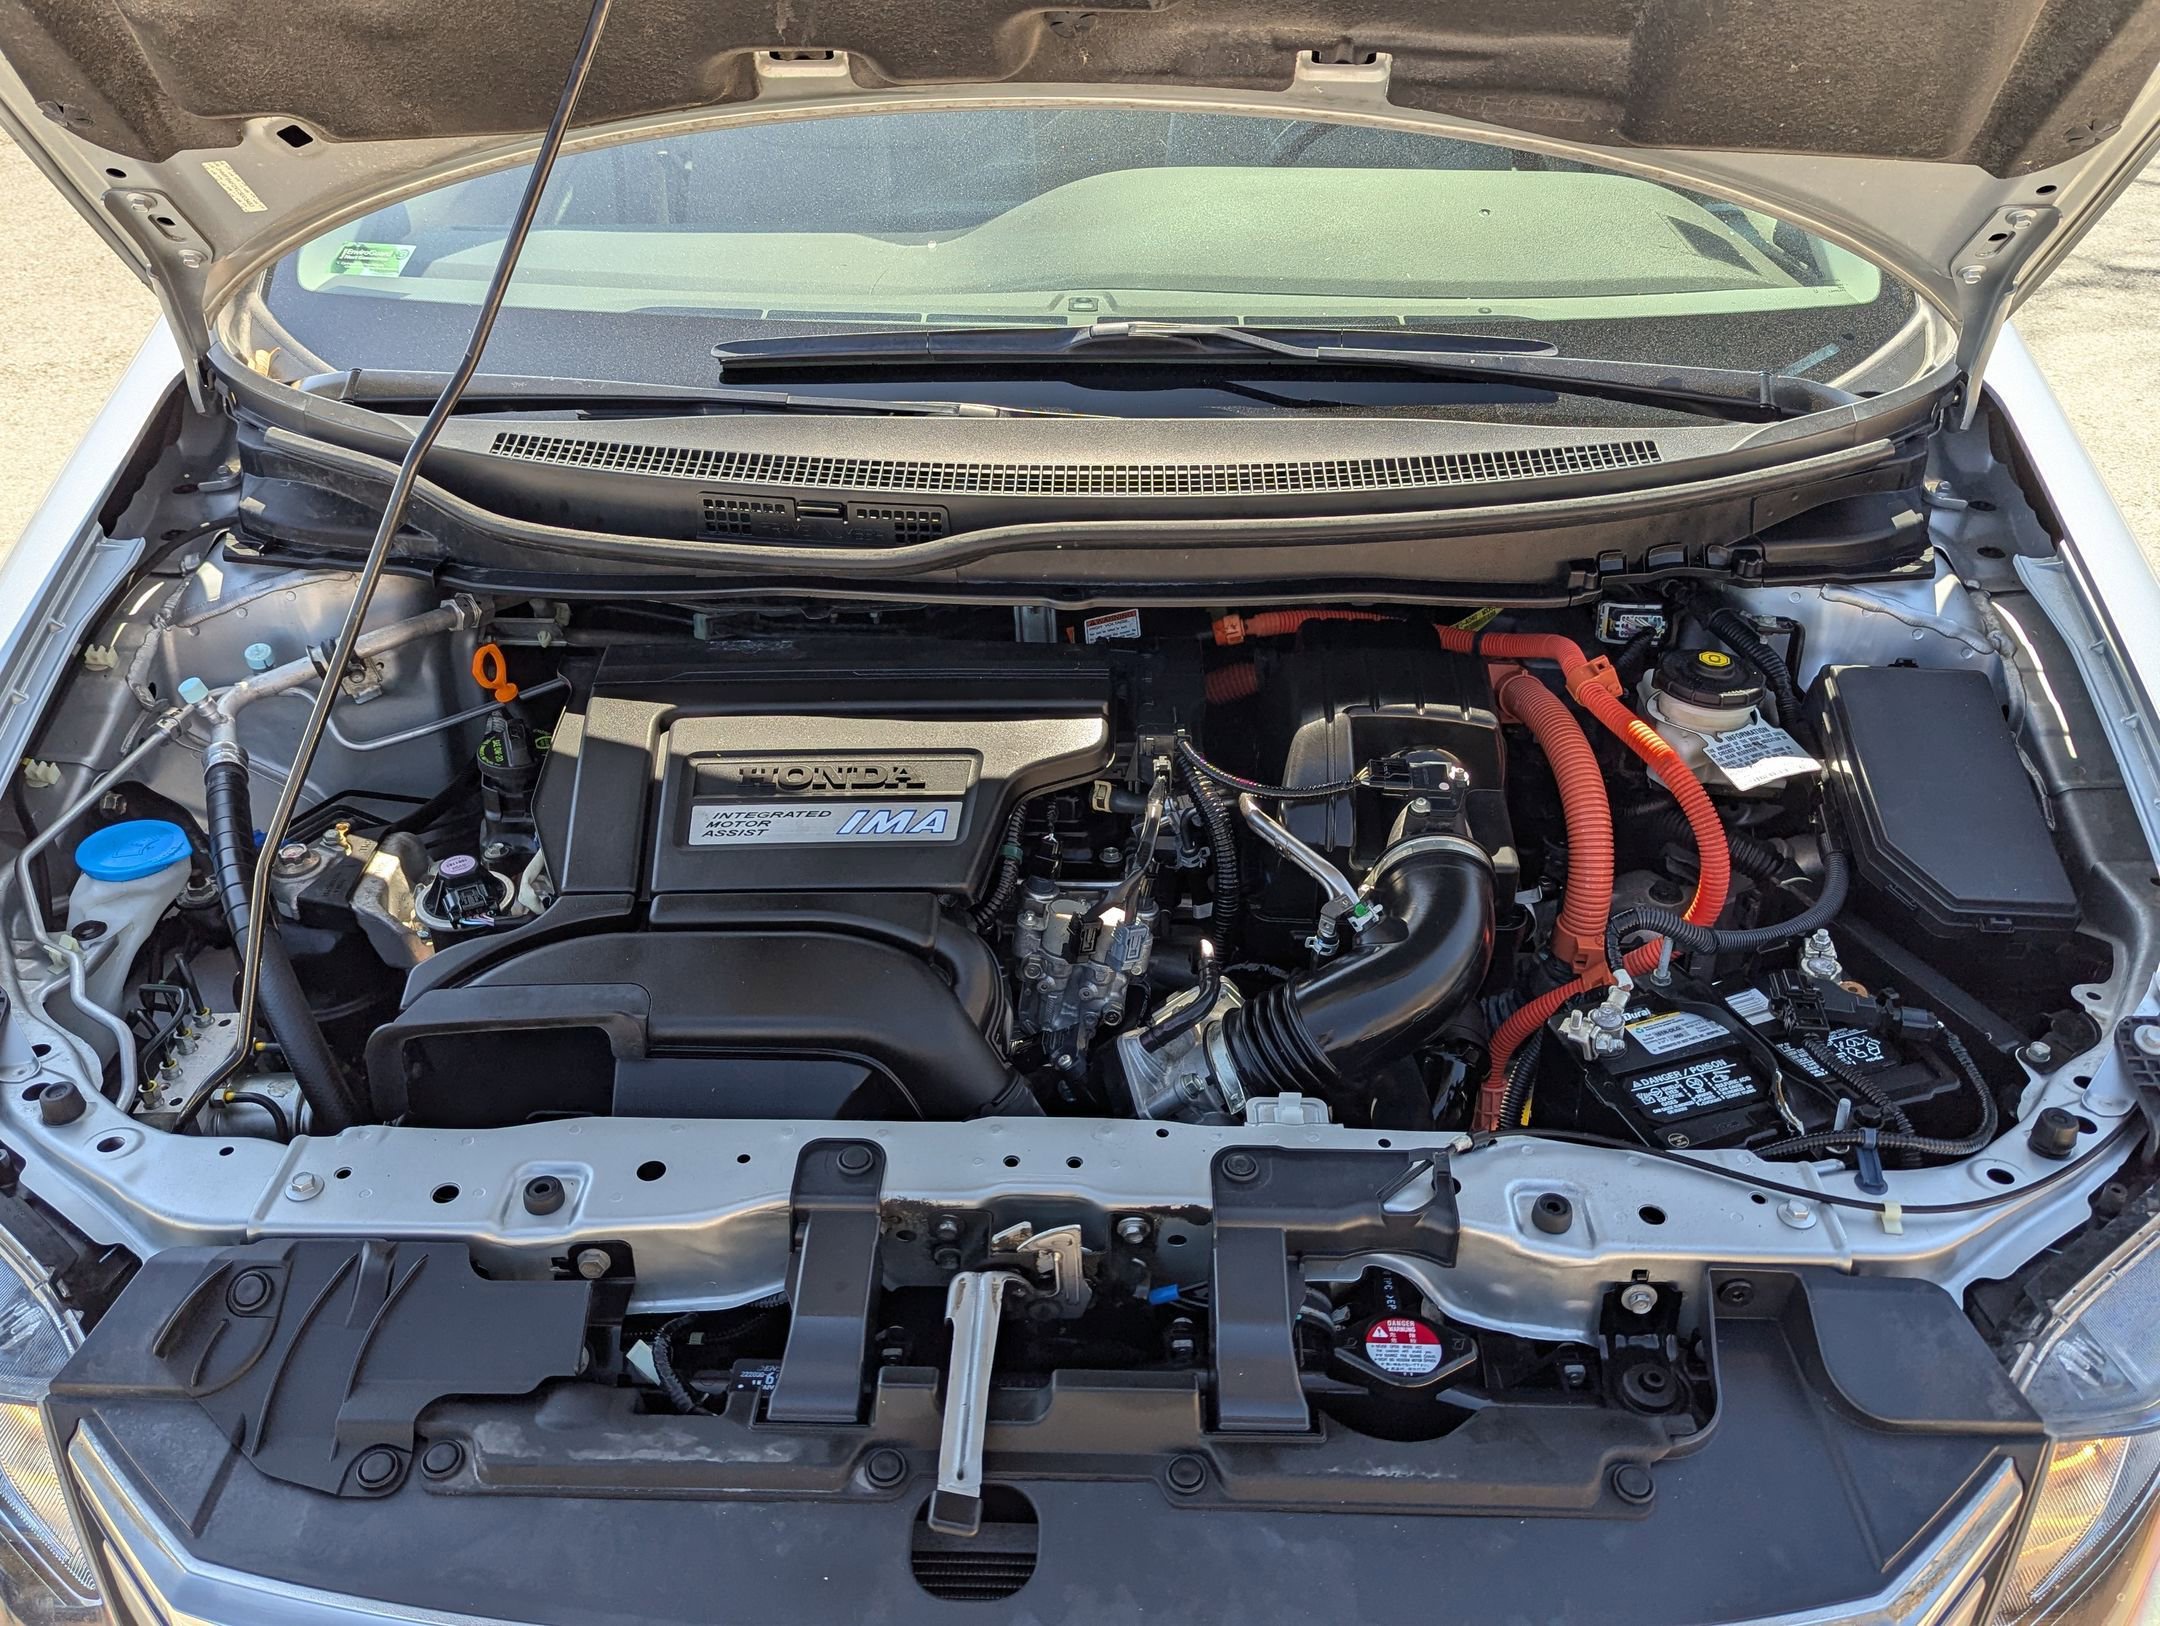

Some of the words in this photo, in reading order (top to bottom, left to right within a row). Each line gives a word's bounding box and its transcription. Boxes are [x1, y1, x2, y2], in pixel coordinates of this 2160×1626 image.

[1724, 727, 1770, 742] INFORMATION
[736, 764, 926, 793] HONDA
[714, 810, 832, 819] INTEGRATED
[836, 809, 948, 835] IMA
[707, 820, 772, 828] MOTOR
[702, 829, 769, 838] ASSIST
[1640, 1070, 1682, 1086] DANGER
[1690, 1059, 1728, 1074] POISON
